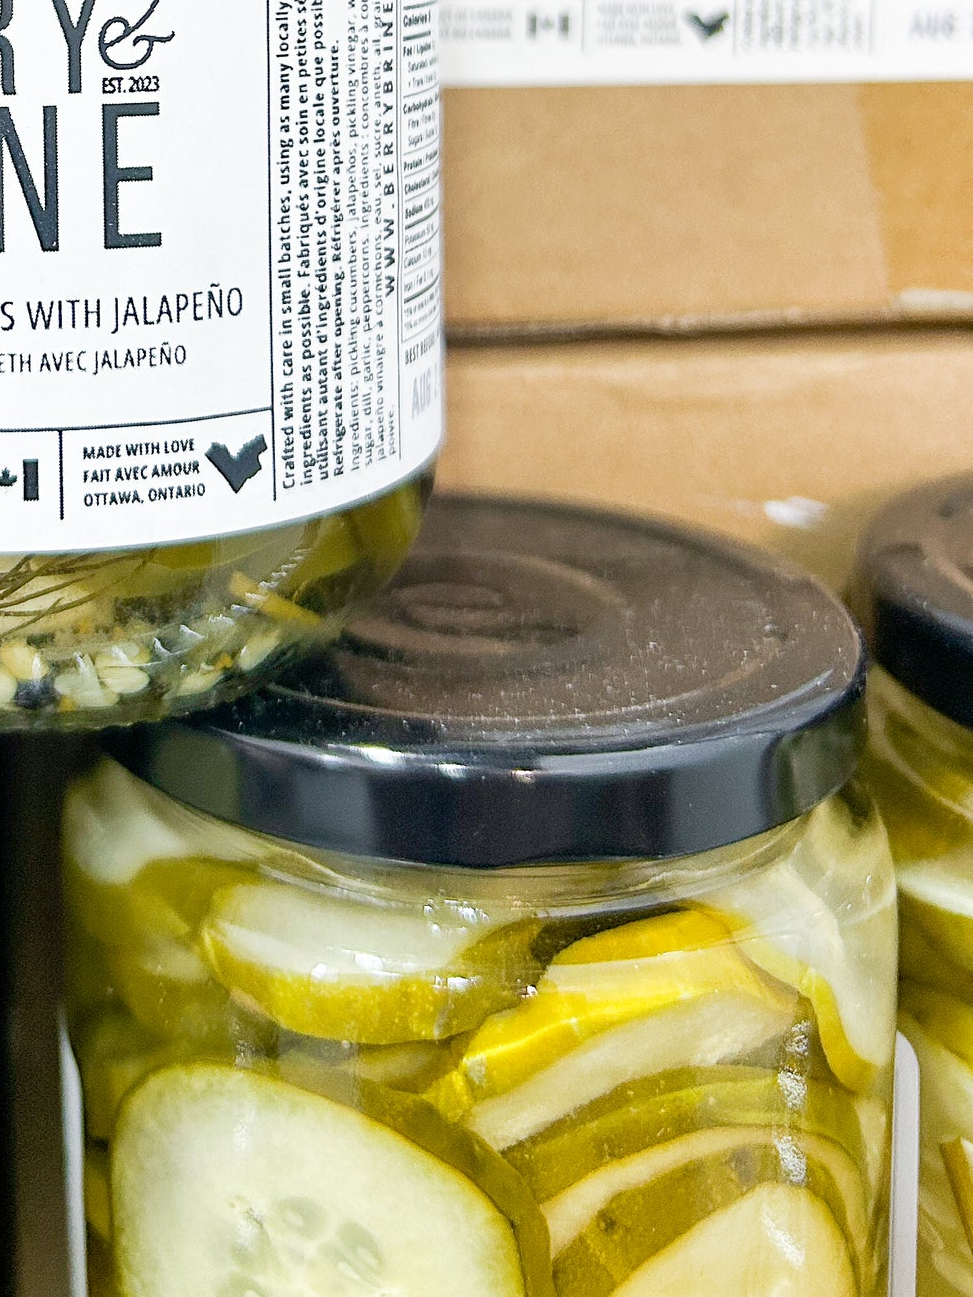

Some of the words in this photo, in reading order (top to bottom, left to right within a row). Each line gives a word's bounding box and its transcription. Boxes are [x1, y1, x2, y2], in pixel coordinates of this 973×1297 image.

[276, 2, 292, 57] locally
[295, 19, 310, 77] petites
[102, 77, 126, 94] EST.
[129, 76, 160, 93] 2023
[279, 63, 293, 110] many
[314, 57, 326, 87] que
[297, 84, 308, 103] en
[280, 116, 290, 133] as
[296, 109, 308, 144] soin
[313, 93, 325, 143] locale
[277, 139, 293, 184] using
[298, 150, 309, 188] avec
[331, 130, 343, 174] après
[277, 190, 292, 263] batches,
[296, 193, 313, 277] Fabriqués
[26, 294, 101, 331] WITH
[110, 283, 244, 333] JALAPEÑO
[278, 269, 292, 313] small
[278, 319, 292, 335] in
[298, 283, 314, 359] possible.
[38, 350, 86, 372] AVEC
[92, 342, 187, 375] JALAPEÑO
[281, 340, 293, 376] care
[301, 365, 312, 382] as
[317, 349, 328, 404] autant
[331, 341, 342, 380] after
[280, 382, 294, 421] with
[83, 442, 120, 460] MADE
[124, 440, 160, 458] WITH
[164, 438, 195, 454] LOVE
[299, 387, 316, 484] ingredients
[333, 385, 346, 476] Refrigerate
[83, 465, 109, 484] FAIT
[114, 464, 149, 481] AVEC
[151, 460, 200, 479] AMOUR
[280, 426, 295, 489] Crafted
[84, 488, 144, 507] OTTAWA,
[149, 483, 206, 502] ONTARIO
